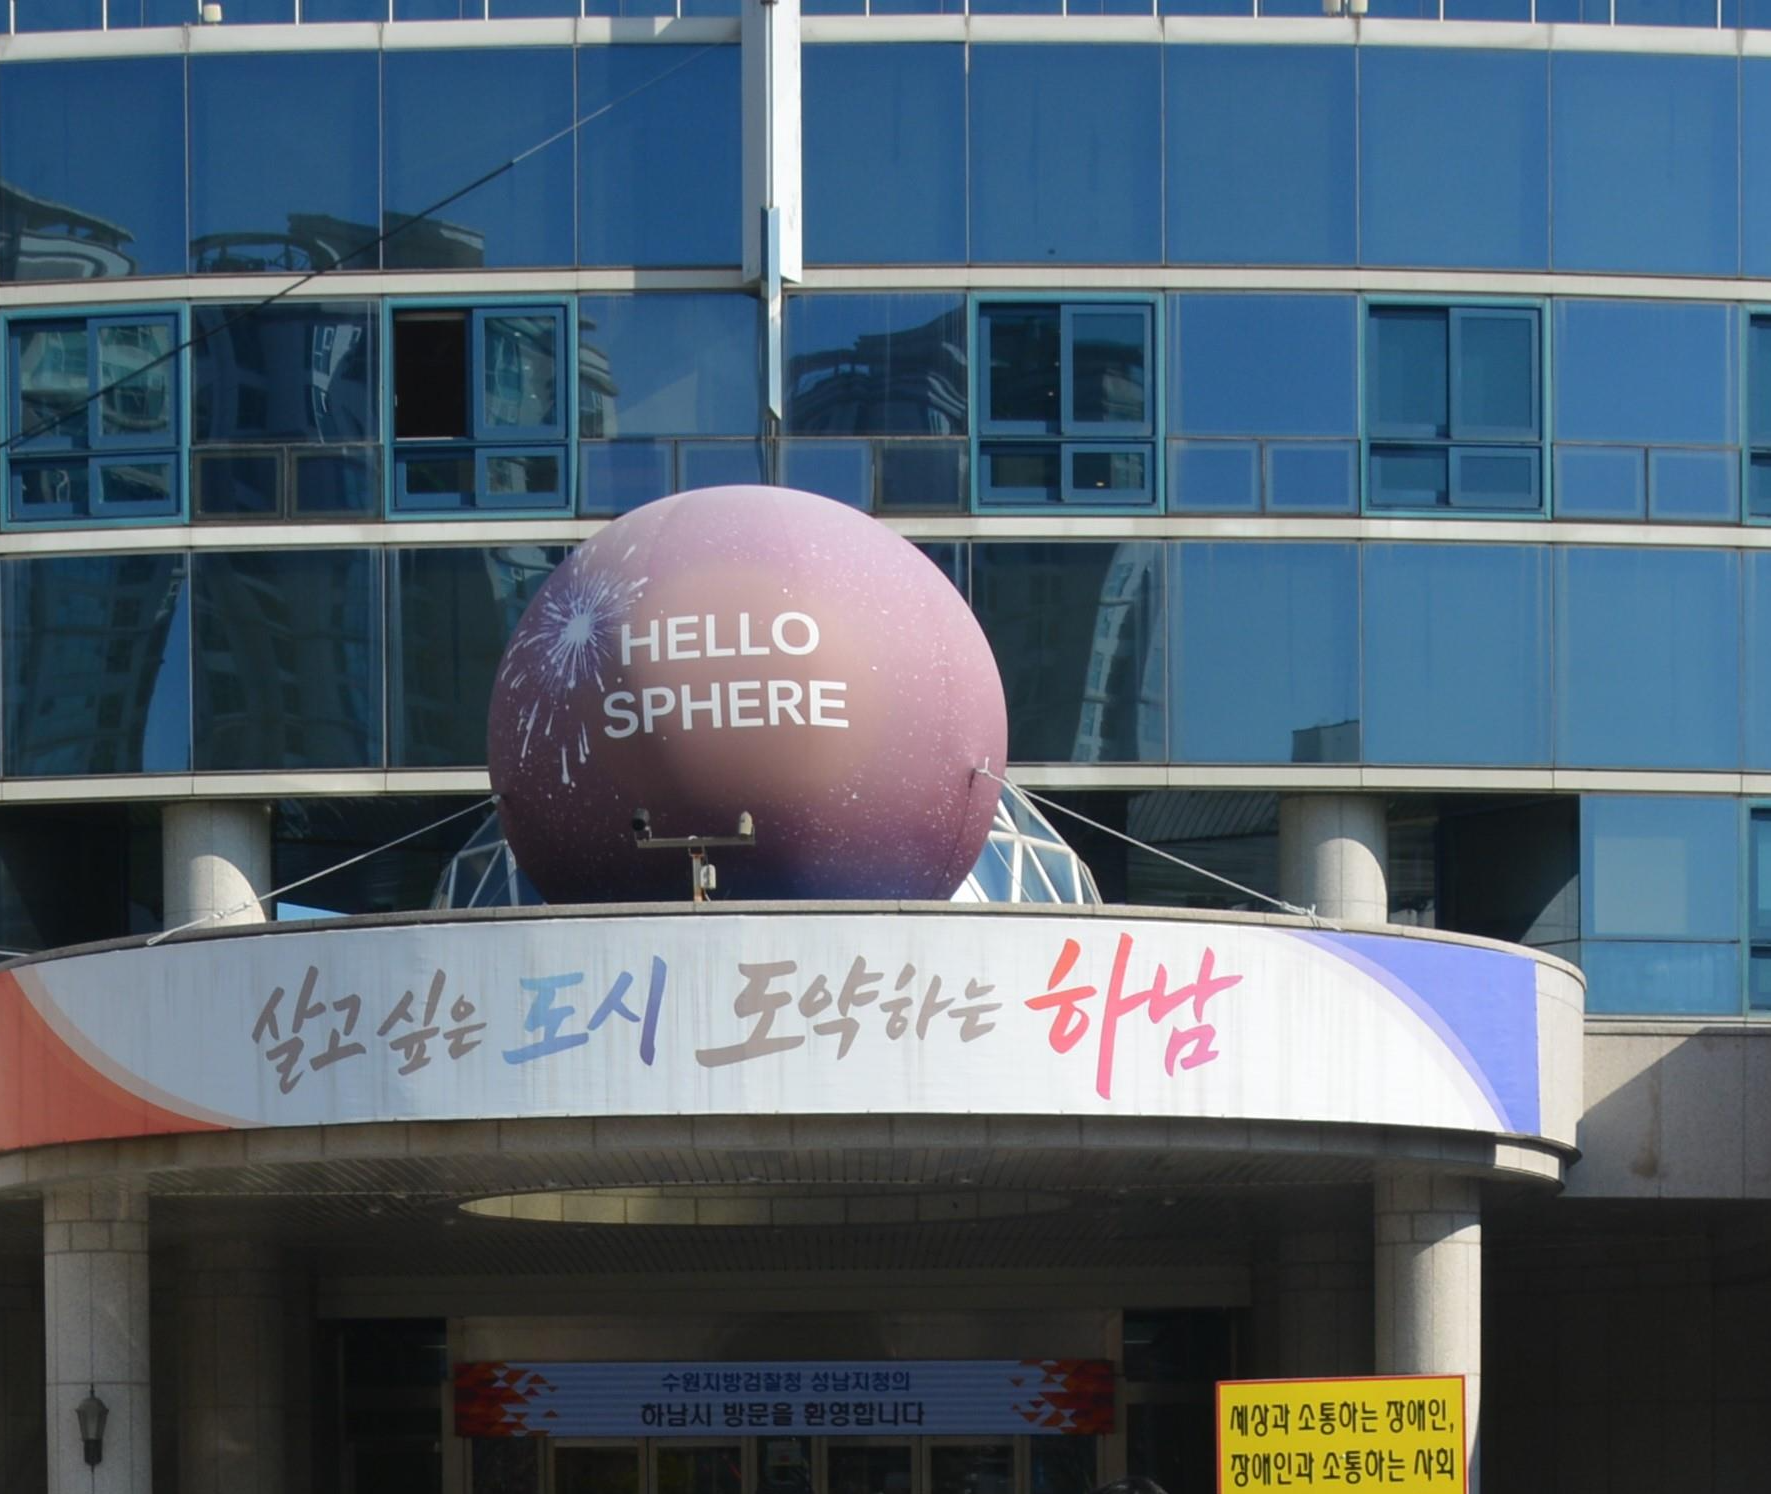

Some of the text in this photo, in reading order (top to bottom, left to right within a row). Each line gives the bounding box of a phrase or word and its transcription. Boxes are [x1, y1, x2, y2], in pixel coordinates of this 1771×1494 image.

[621, 611, 820, 666] HELLO
[603, 679, 849, 739] SPHERE
[251, 932, 1244, 1100] 살고 싶은 도시 도약하는 하남
[661, 1371, 910, 1393] 수원지방검찰청 성남지청의
[640, 1401, 924, 1428] 하남시 방문을 환영합니다
[1230, 1399, 1454, 1437] 세상과 소통하는 장애인,
[1231, 1448, 1455, 1487] 장애인과 소통하는 사회
